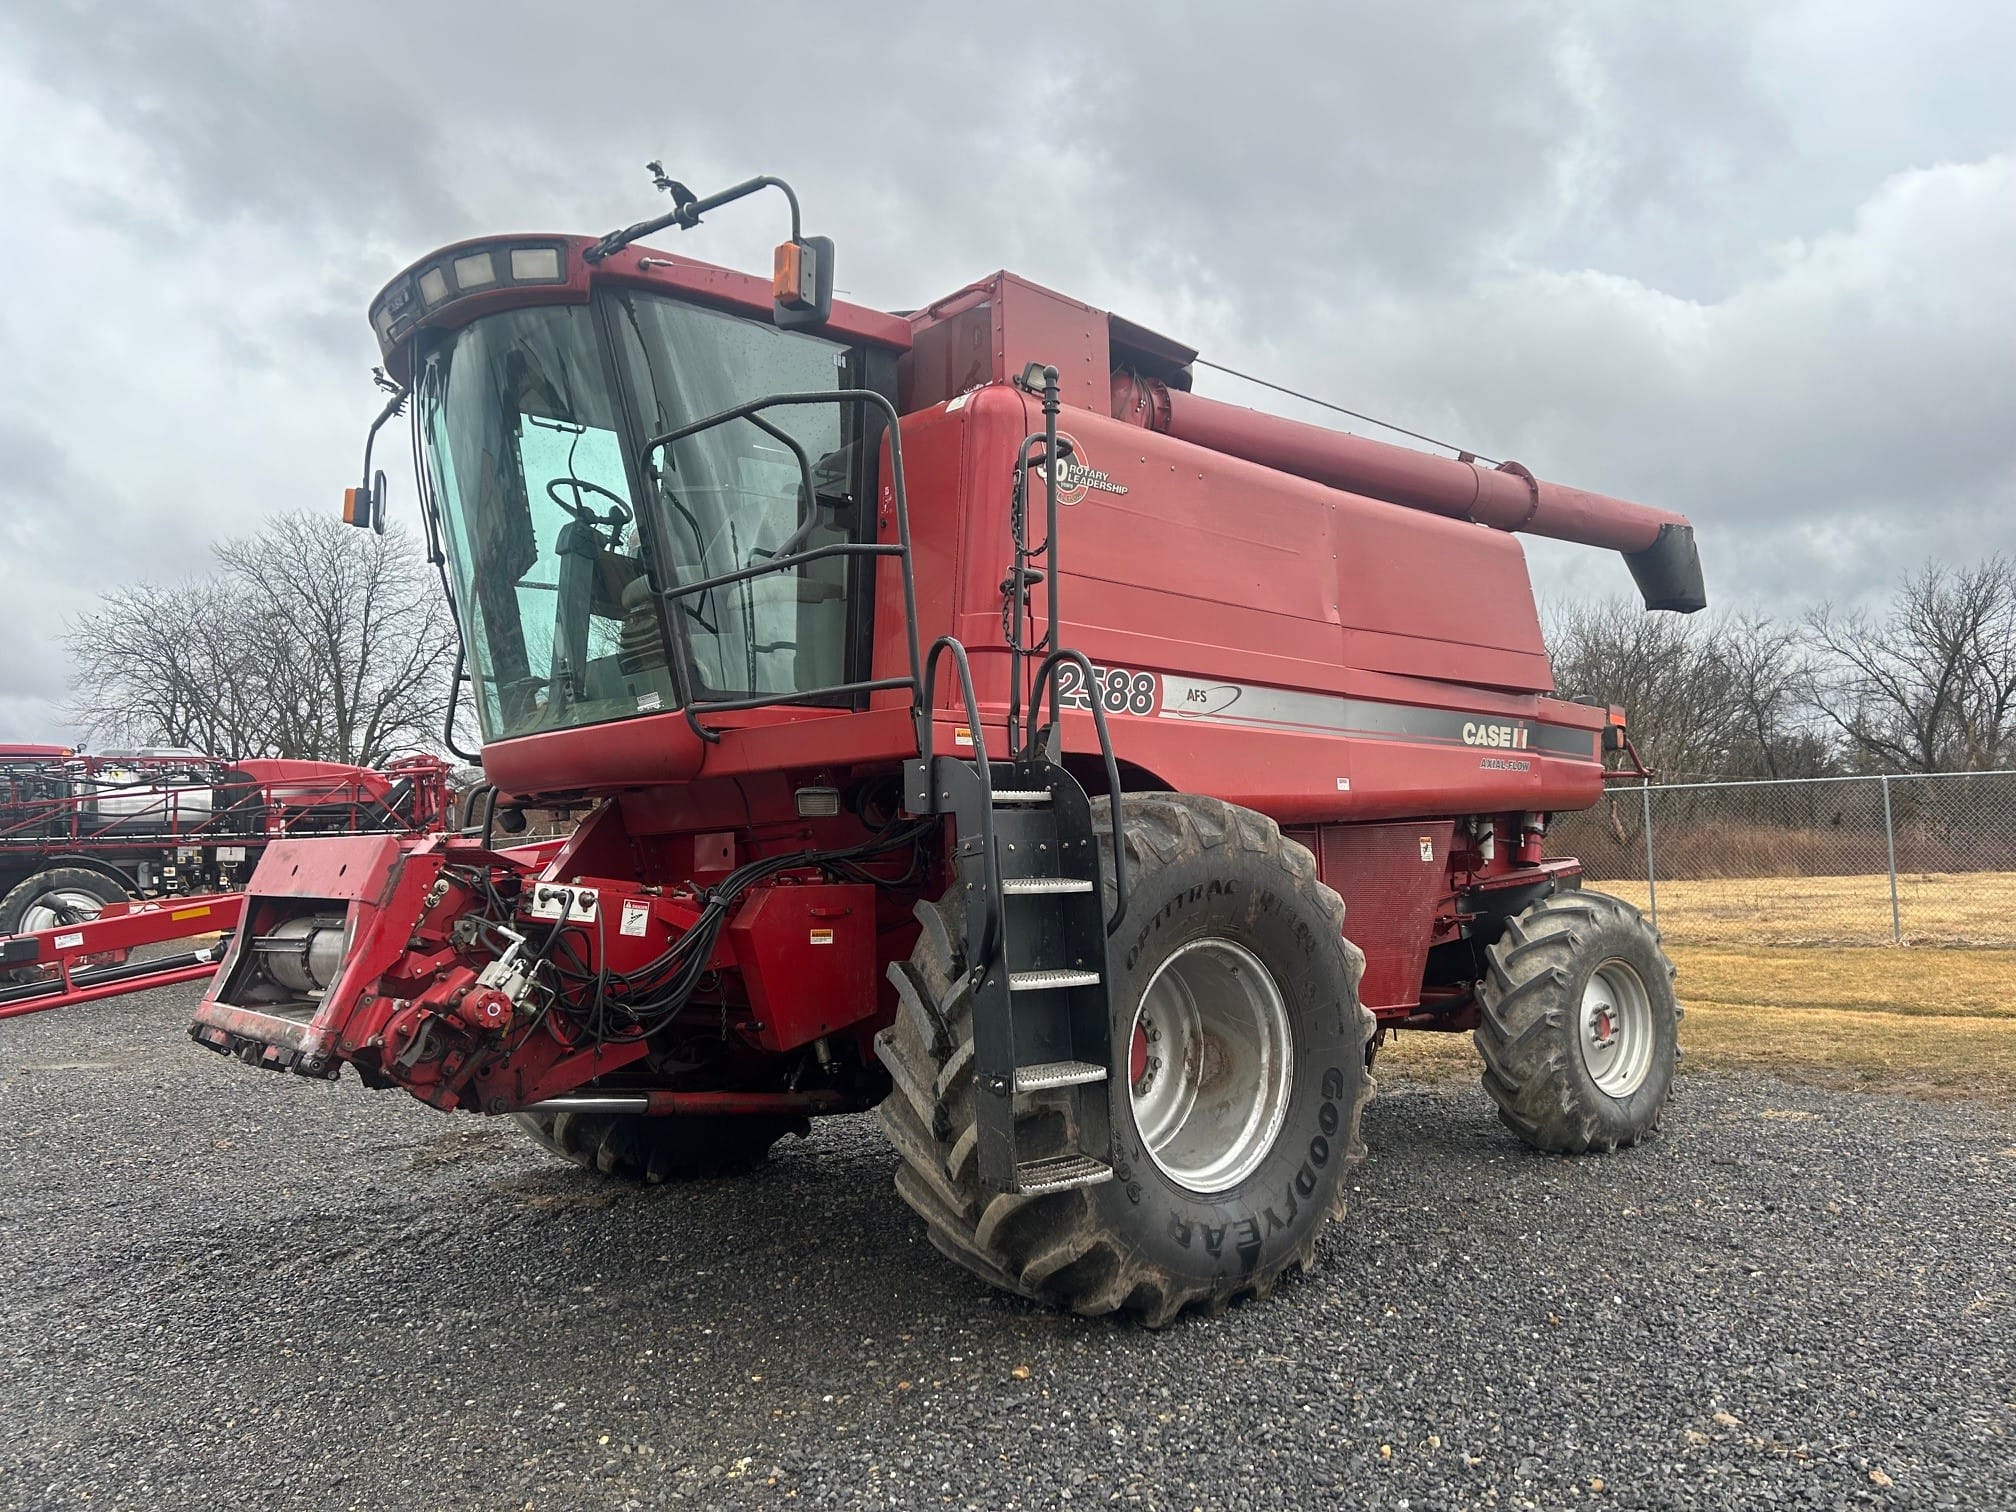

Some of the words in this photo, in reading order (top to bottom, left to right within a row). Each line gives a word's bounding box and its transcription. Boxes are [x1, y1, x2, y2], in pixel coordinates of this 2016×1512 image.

[1067, 474, 1128, 495] LEADERSHIP
[1069, 465, 1110, 481] ROTARY
[1057, 662, 1156, 716] 2588
[1186, 688, 1207, 703] AFS
[1462, 722, 1511, 748] CASE
[1481, 758, 1529, 771] AXIAL-FLOW
[1126, 879, 1240, 971] OPTITRAC
[1167, 1067, 1343, 1257] GOODYEAR
